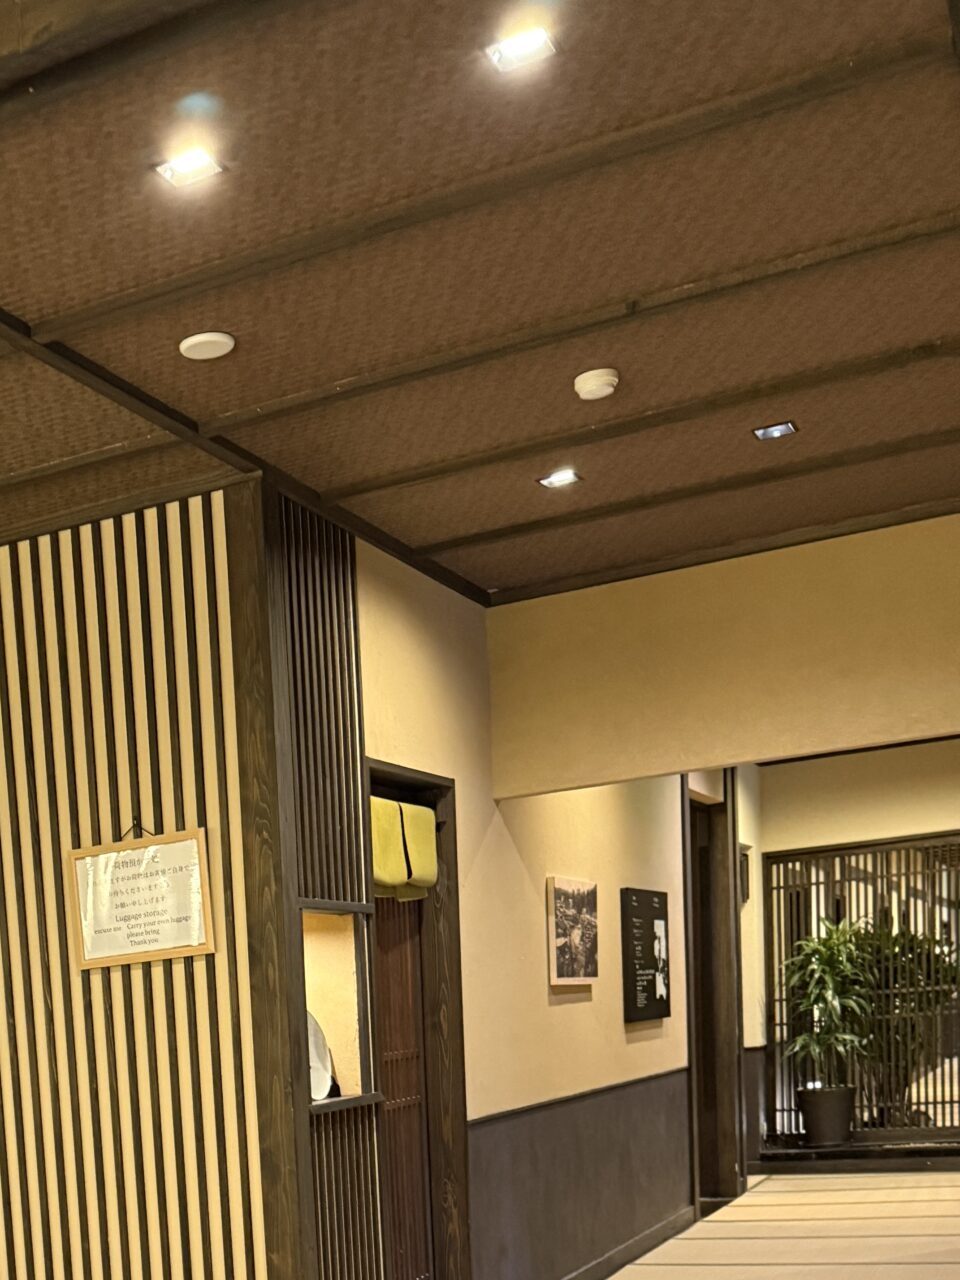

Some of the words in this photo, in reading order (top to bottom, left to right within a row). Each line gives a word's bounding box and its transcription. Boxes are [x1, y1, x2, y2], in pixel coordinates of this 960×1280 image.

[115, 912, 142, 923] Luggage
[126, 921, 142, 931] Carry
[129, 938, 147, 947] Thank
